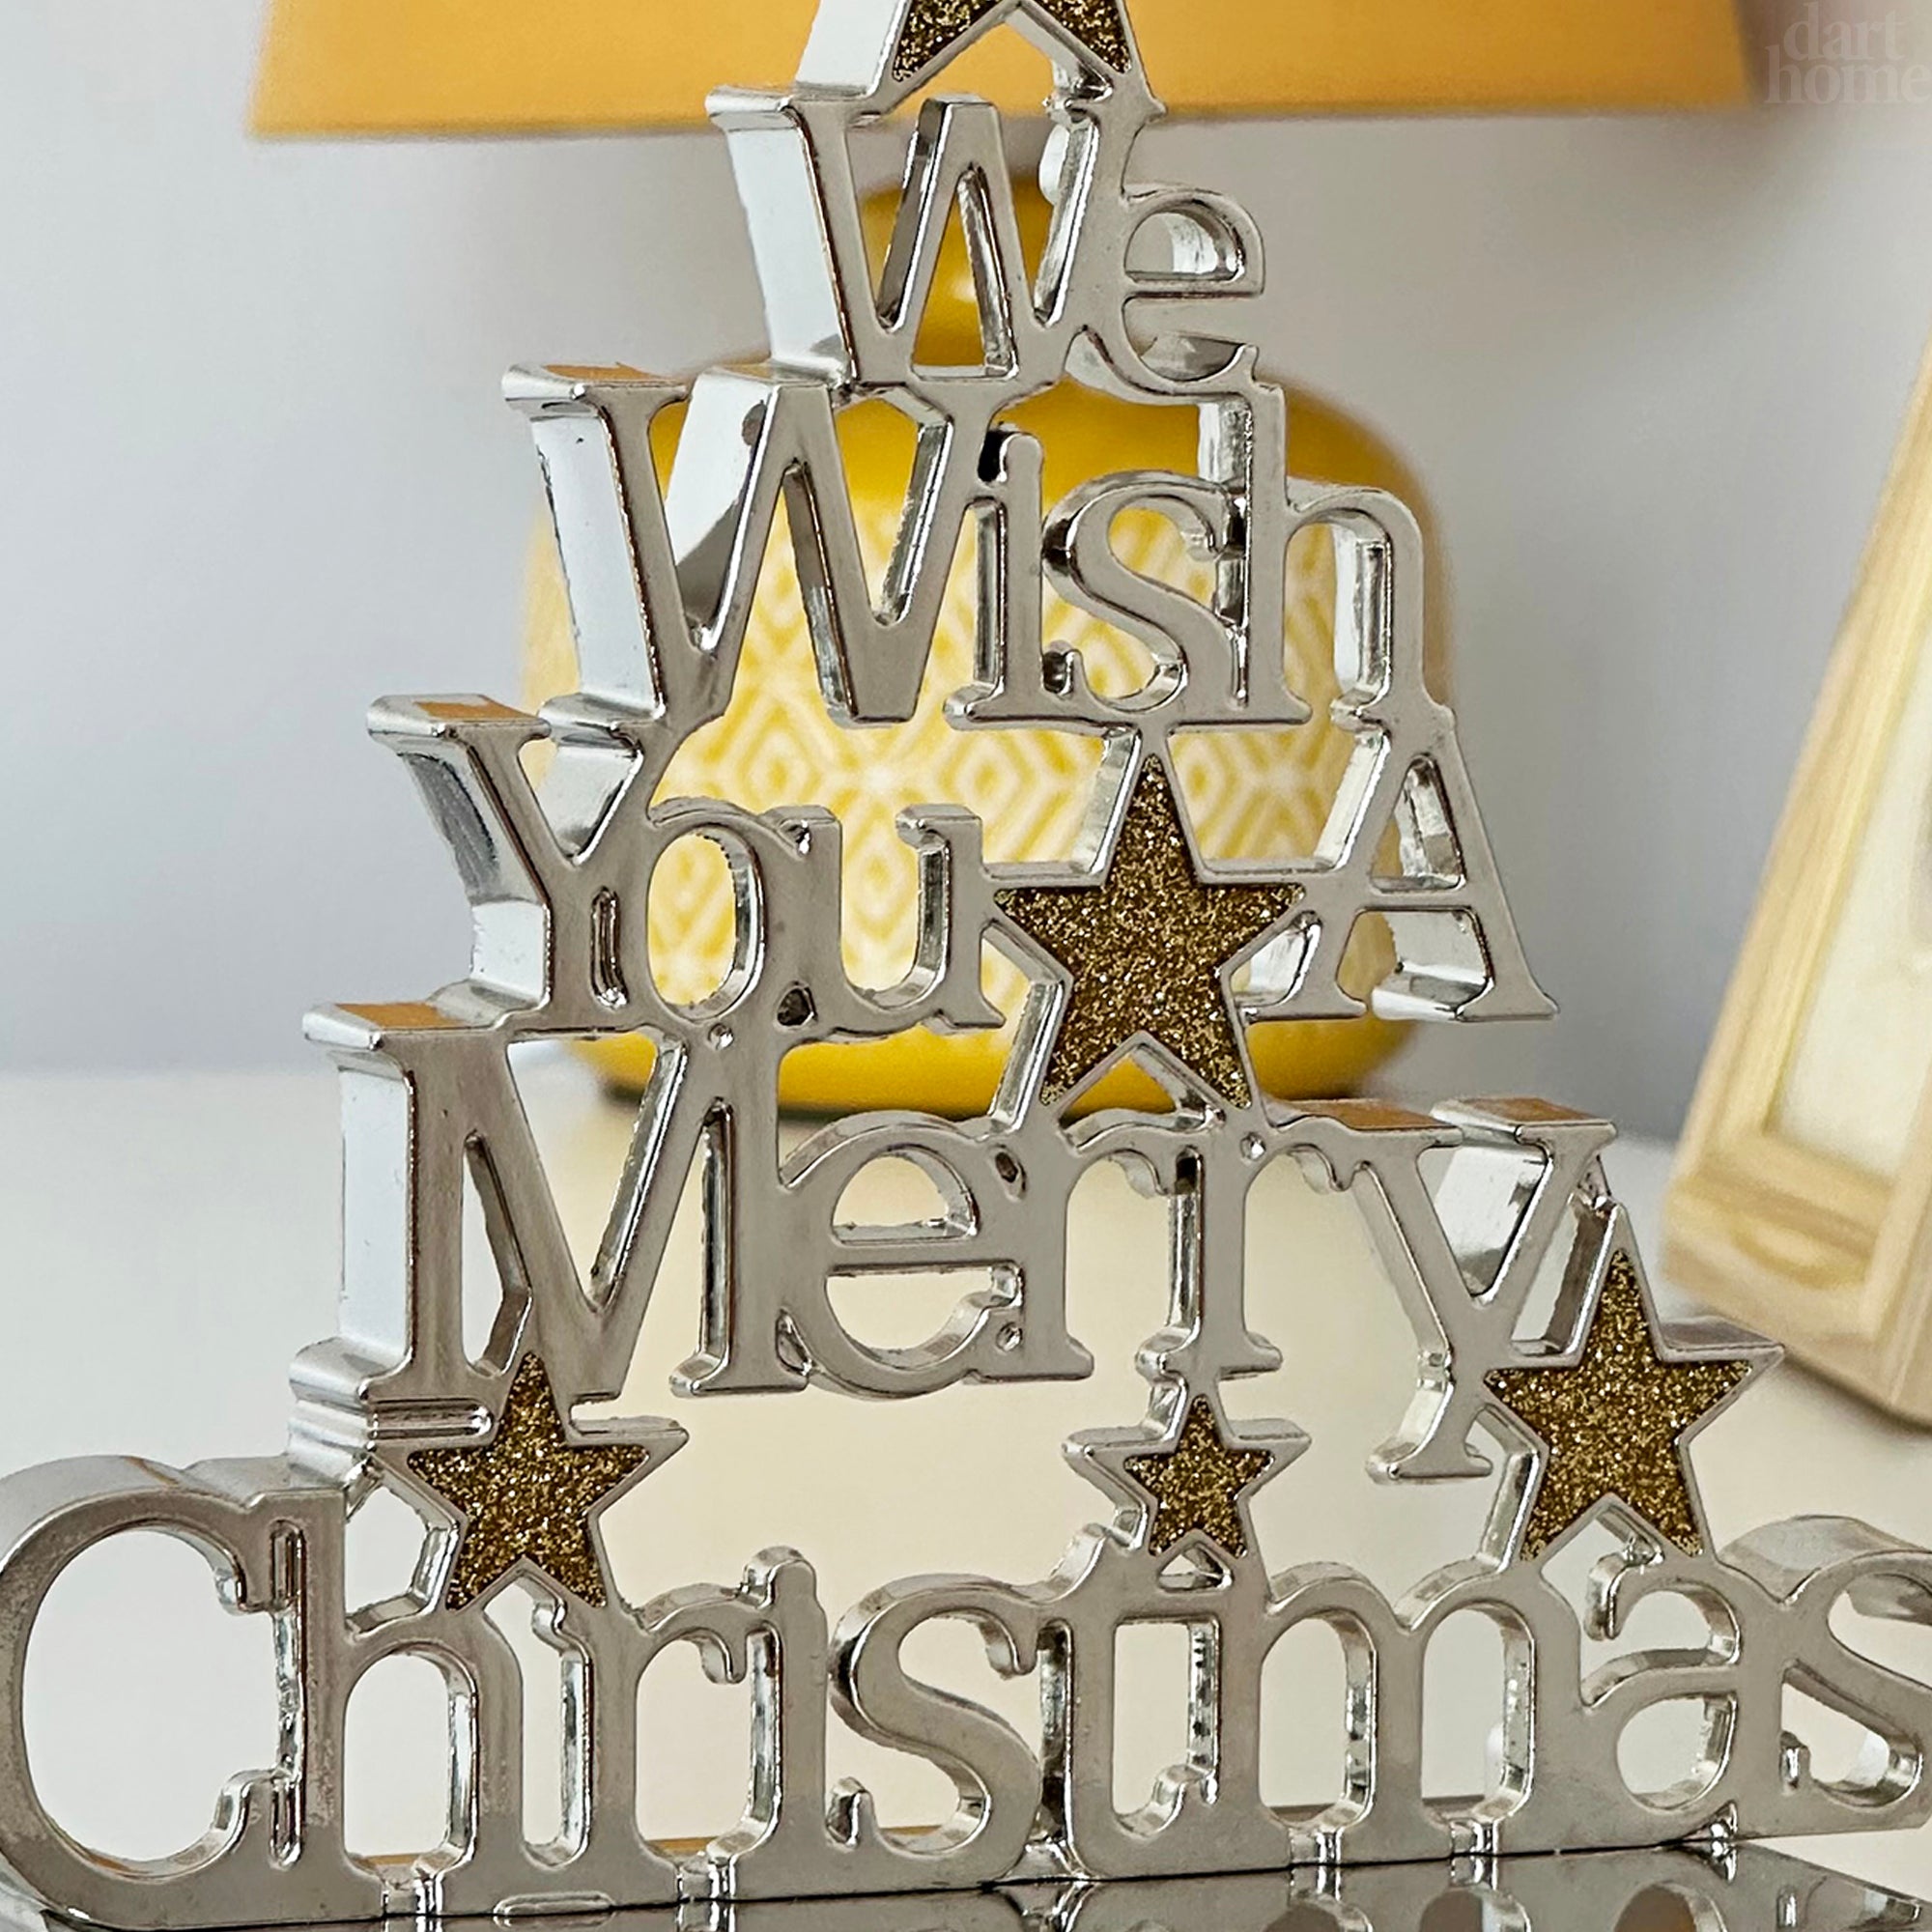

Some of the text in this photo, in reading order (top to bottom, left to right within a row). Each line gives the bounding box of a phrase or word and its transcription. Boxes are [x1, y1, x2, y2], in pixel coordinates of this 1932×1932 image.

[709, 89, 1265, 398] We
[502, 361, 1439, 726] Wish
[367, 694, 1560, 1032] You A
[295, 1003, 1615, 1480] Merry
[0, 1451, 1932, 1928] Christmas
